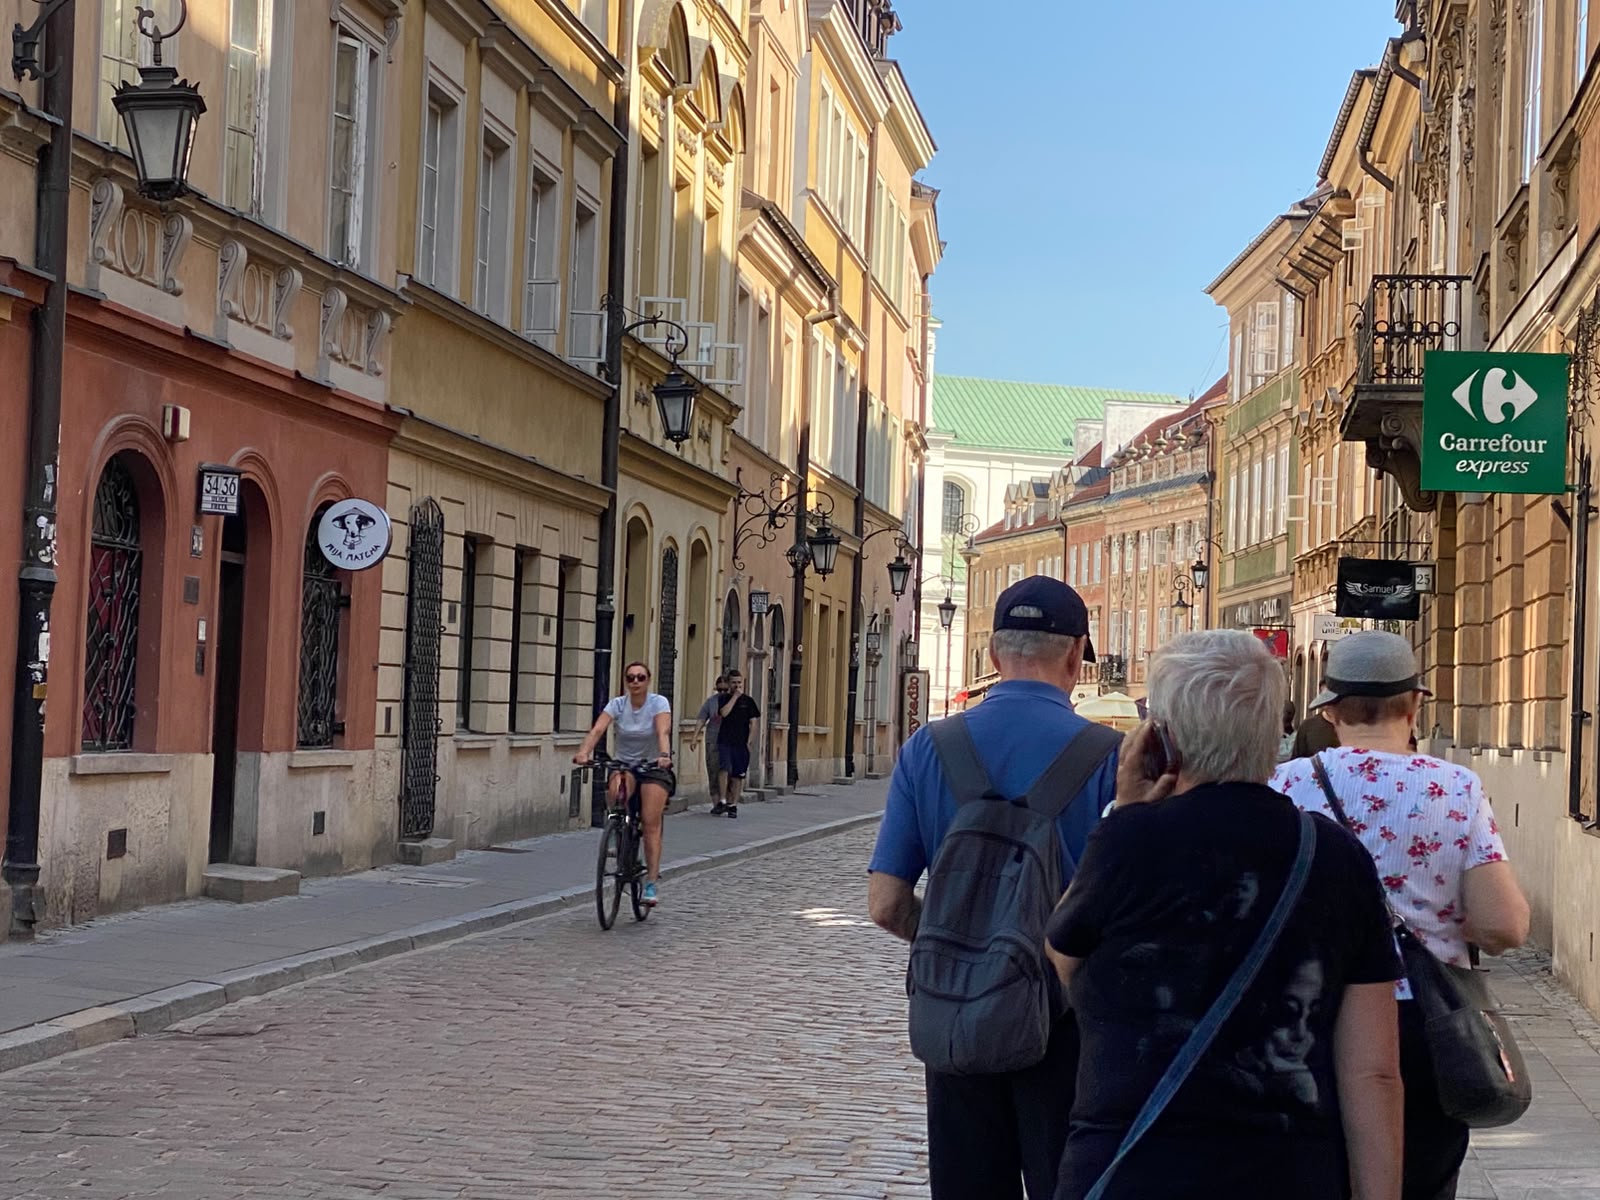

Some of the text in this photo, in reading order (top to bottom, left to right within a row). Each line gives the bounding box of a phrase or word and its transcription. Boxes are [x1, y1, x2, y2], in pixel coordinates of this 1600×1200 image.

[1440, 432, 1547, 453] Carrefour
[1456, 459, 1530, 480] express
[205, 475, 237, 496] 34 36
[1363, 584, 1394, 593] Samuel
[1416, 574, 1431, 585] 25
